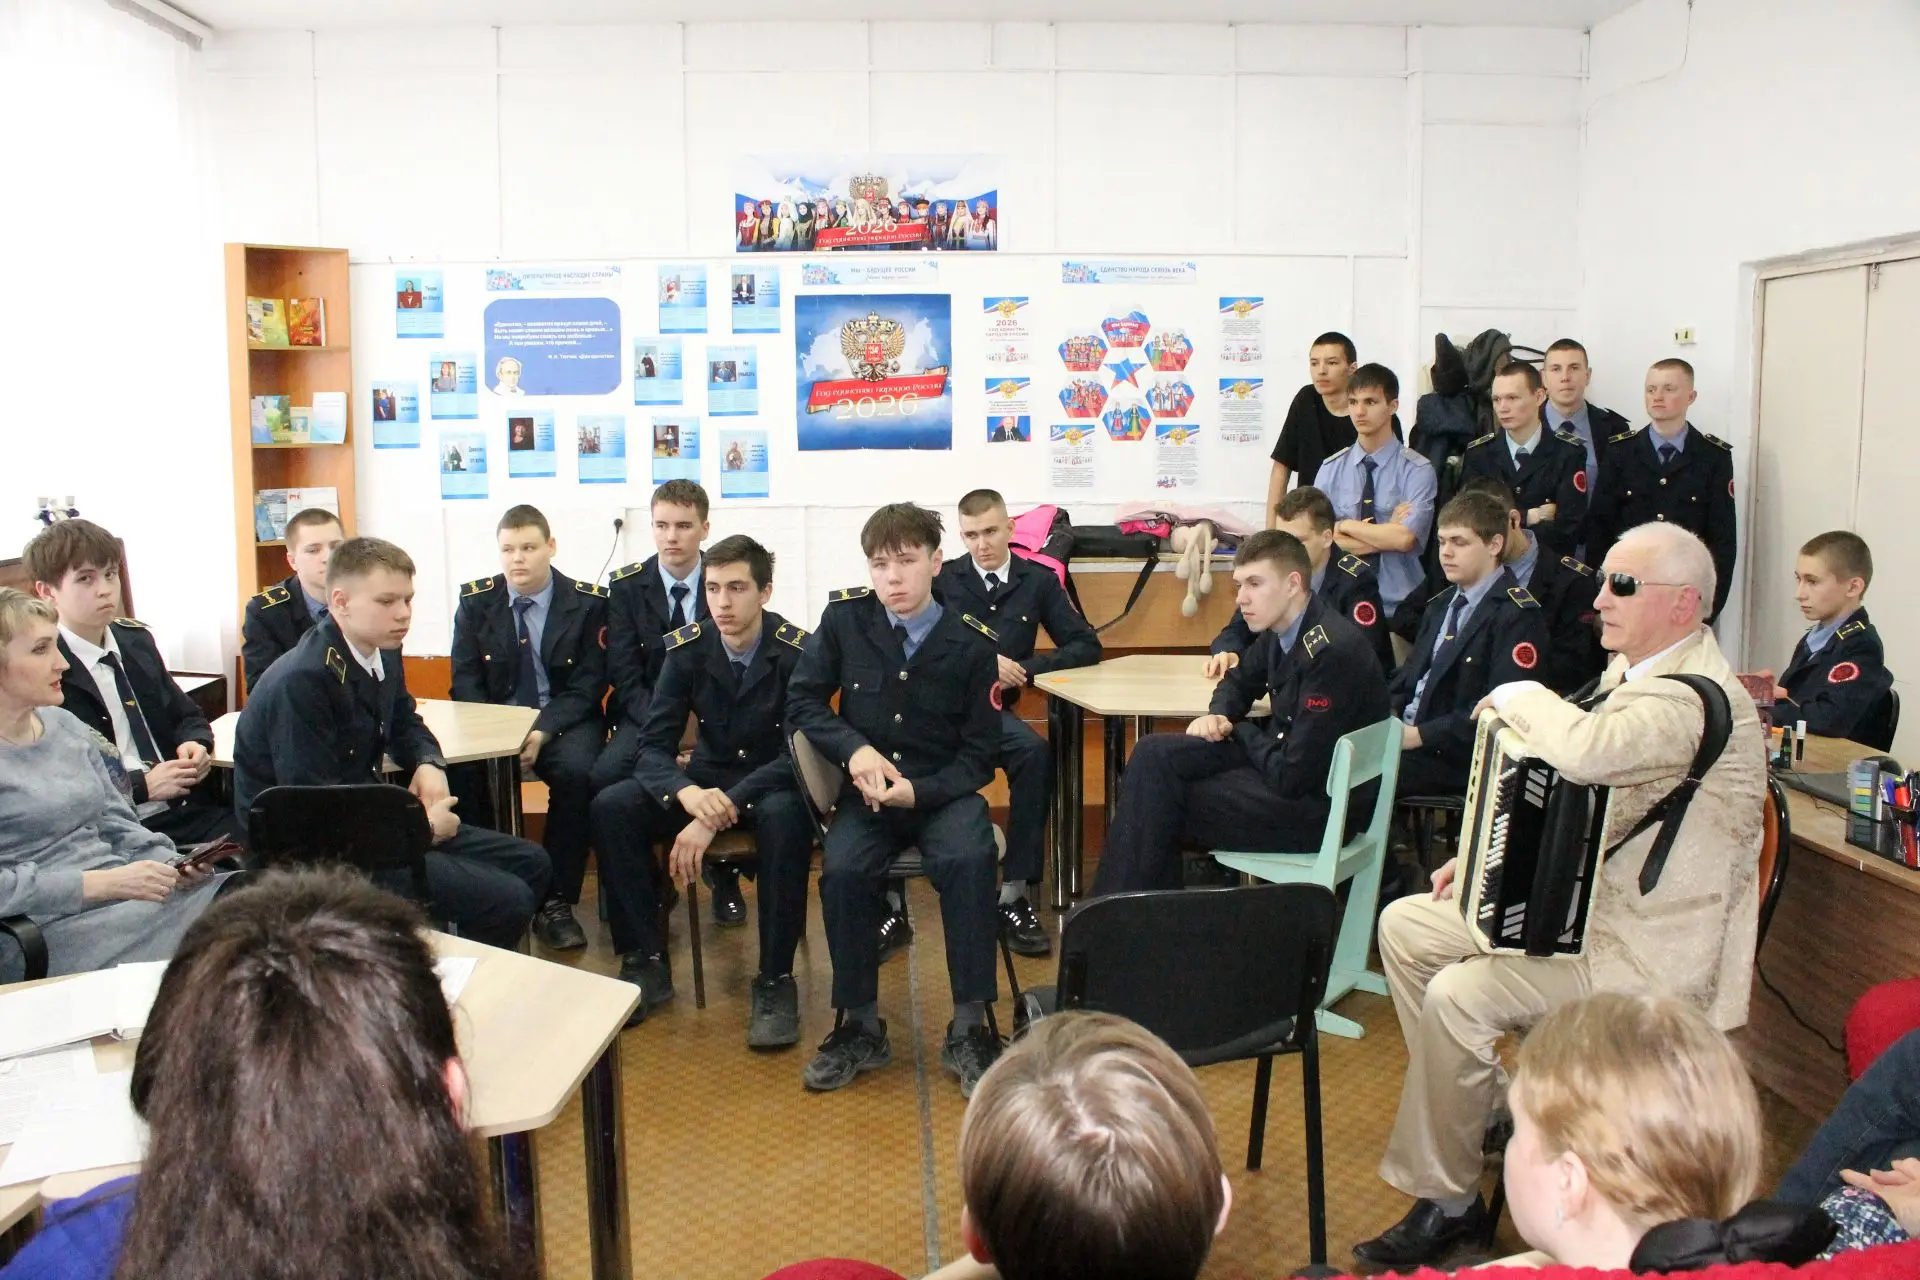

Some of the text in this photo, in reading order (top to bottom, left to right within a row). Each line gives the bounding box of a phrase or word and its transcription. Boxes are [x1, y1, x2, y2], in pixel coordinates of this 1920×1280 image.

[845, 219, 898, 236] 2026
[995, 319, 1018, 327] 2026
[836, 392, 919, 420] 2026
